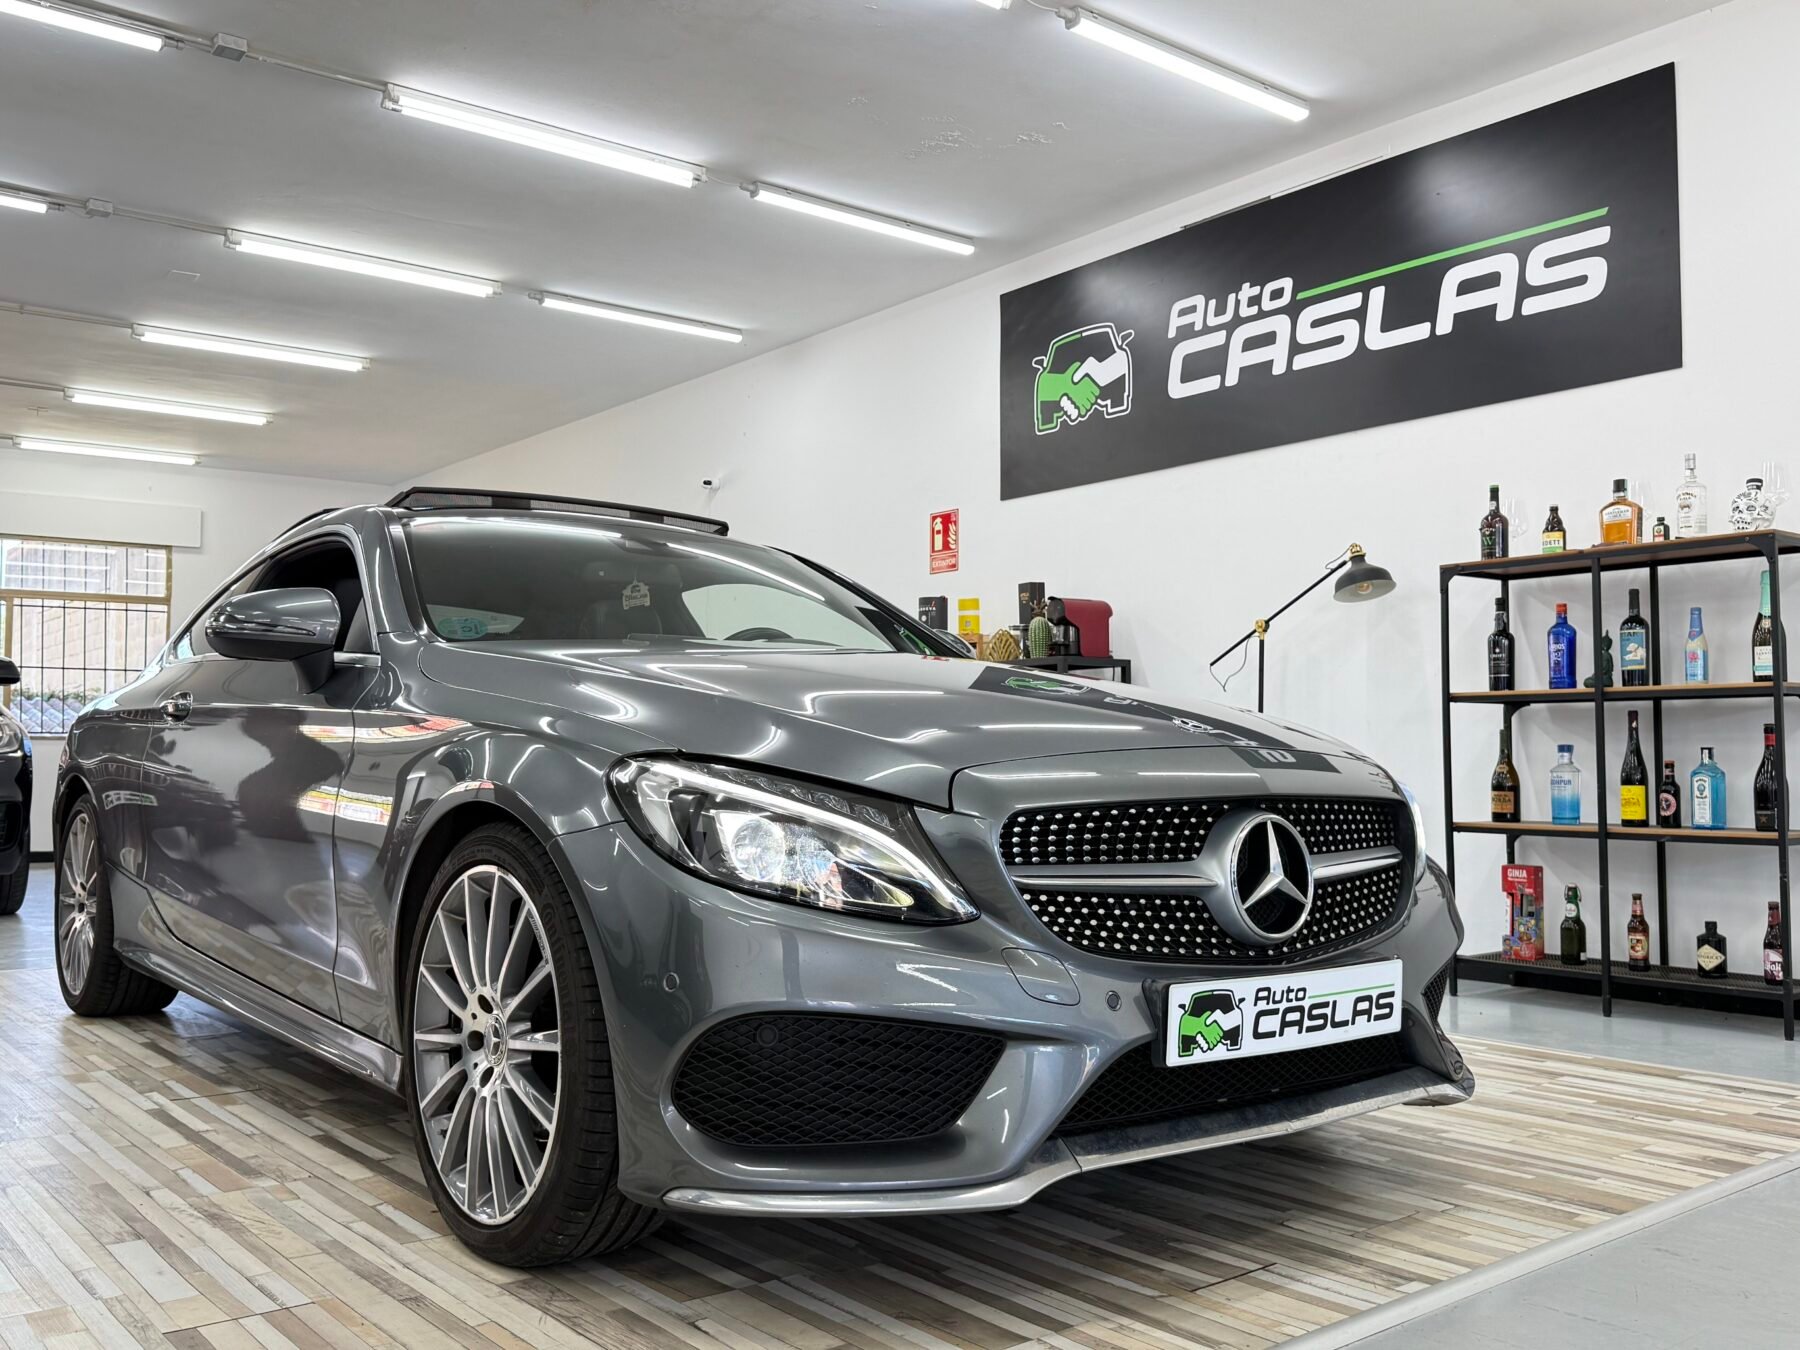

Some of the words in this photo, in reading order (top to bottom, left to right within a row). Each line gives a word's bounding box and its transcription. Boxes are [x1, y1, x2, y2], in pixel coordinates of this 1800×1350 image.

[1166, 276, 1294, 338] Auto
[1167, 225, 1612, 399] CASLAS
[1507, 868, 1528, 879] GINJA
[1252, 991, 1396, 1040] CASLAS
[1253, 985, 1307, 1007] Auto
